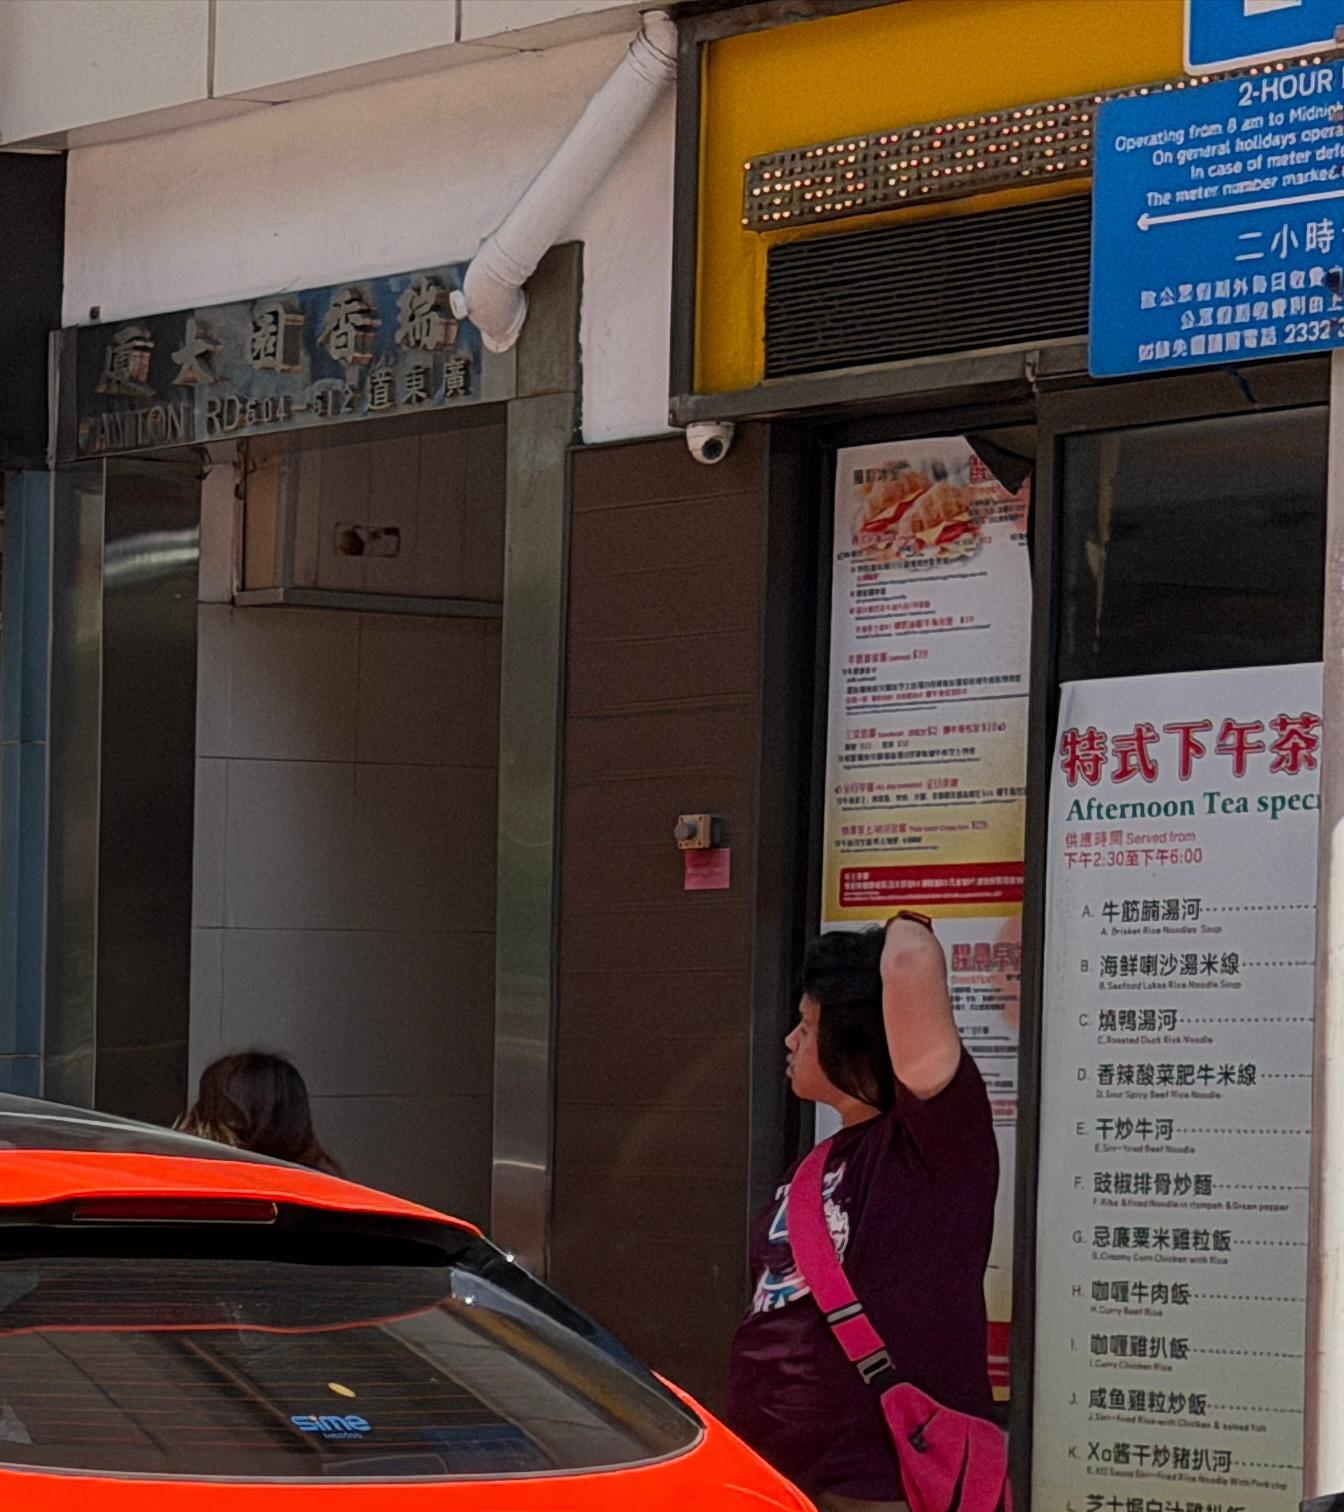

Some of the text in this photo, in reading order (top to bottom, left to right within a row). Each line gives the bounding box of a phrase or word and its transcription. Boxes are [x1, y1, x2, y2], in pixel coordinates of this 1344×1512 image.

[1238, 68, 1333, 107] 2-HOUR
[1115, 129, 1184, 152] Operating
[1189, 123, 1223, 139] from
[1269, 111, 1284, 126] to
[1152, 150, 1173, 166] On
[1177, 142, 1230, 166] general
[1235, 130, 1296, 153] holidays
[1191, 165, 1205, 180] In
[1208, 161, 1242, 178] case
[1247, 156, 1264, 171] of
[1267, 150, 1311, 170] meter
[1147, 191, 1171, 207] The
[1176, 185, 1219, 203] meter
[1222, 173, 1277, 196] number
[1235, 217, 1335, 261] 二小時
[1284, 319, 1331, 344] 2332
[1060, 712, 1321, 787] 特式下午茶
[1066, 797, 1196, 822] Afternoon
[1203, 791, 1249, 815] Tea
[1127, 832, 1166, 846] Served
[1168, 830, 1196, 843] from
[1095, 1118, 1174, 1141] 干炒牛河
